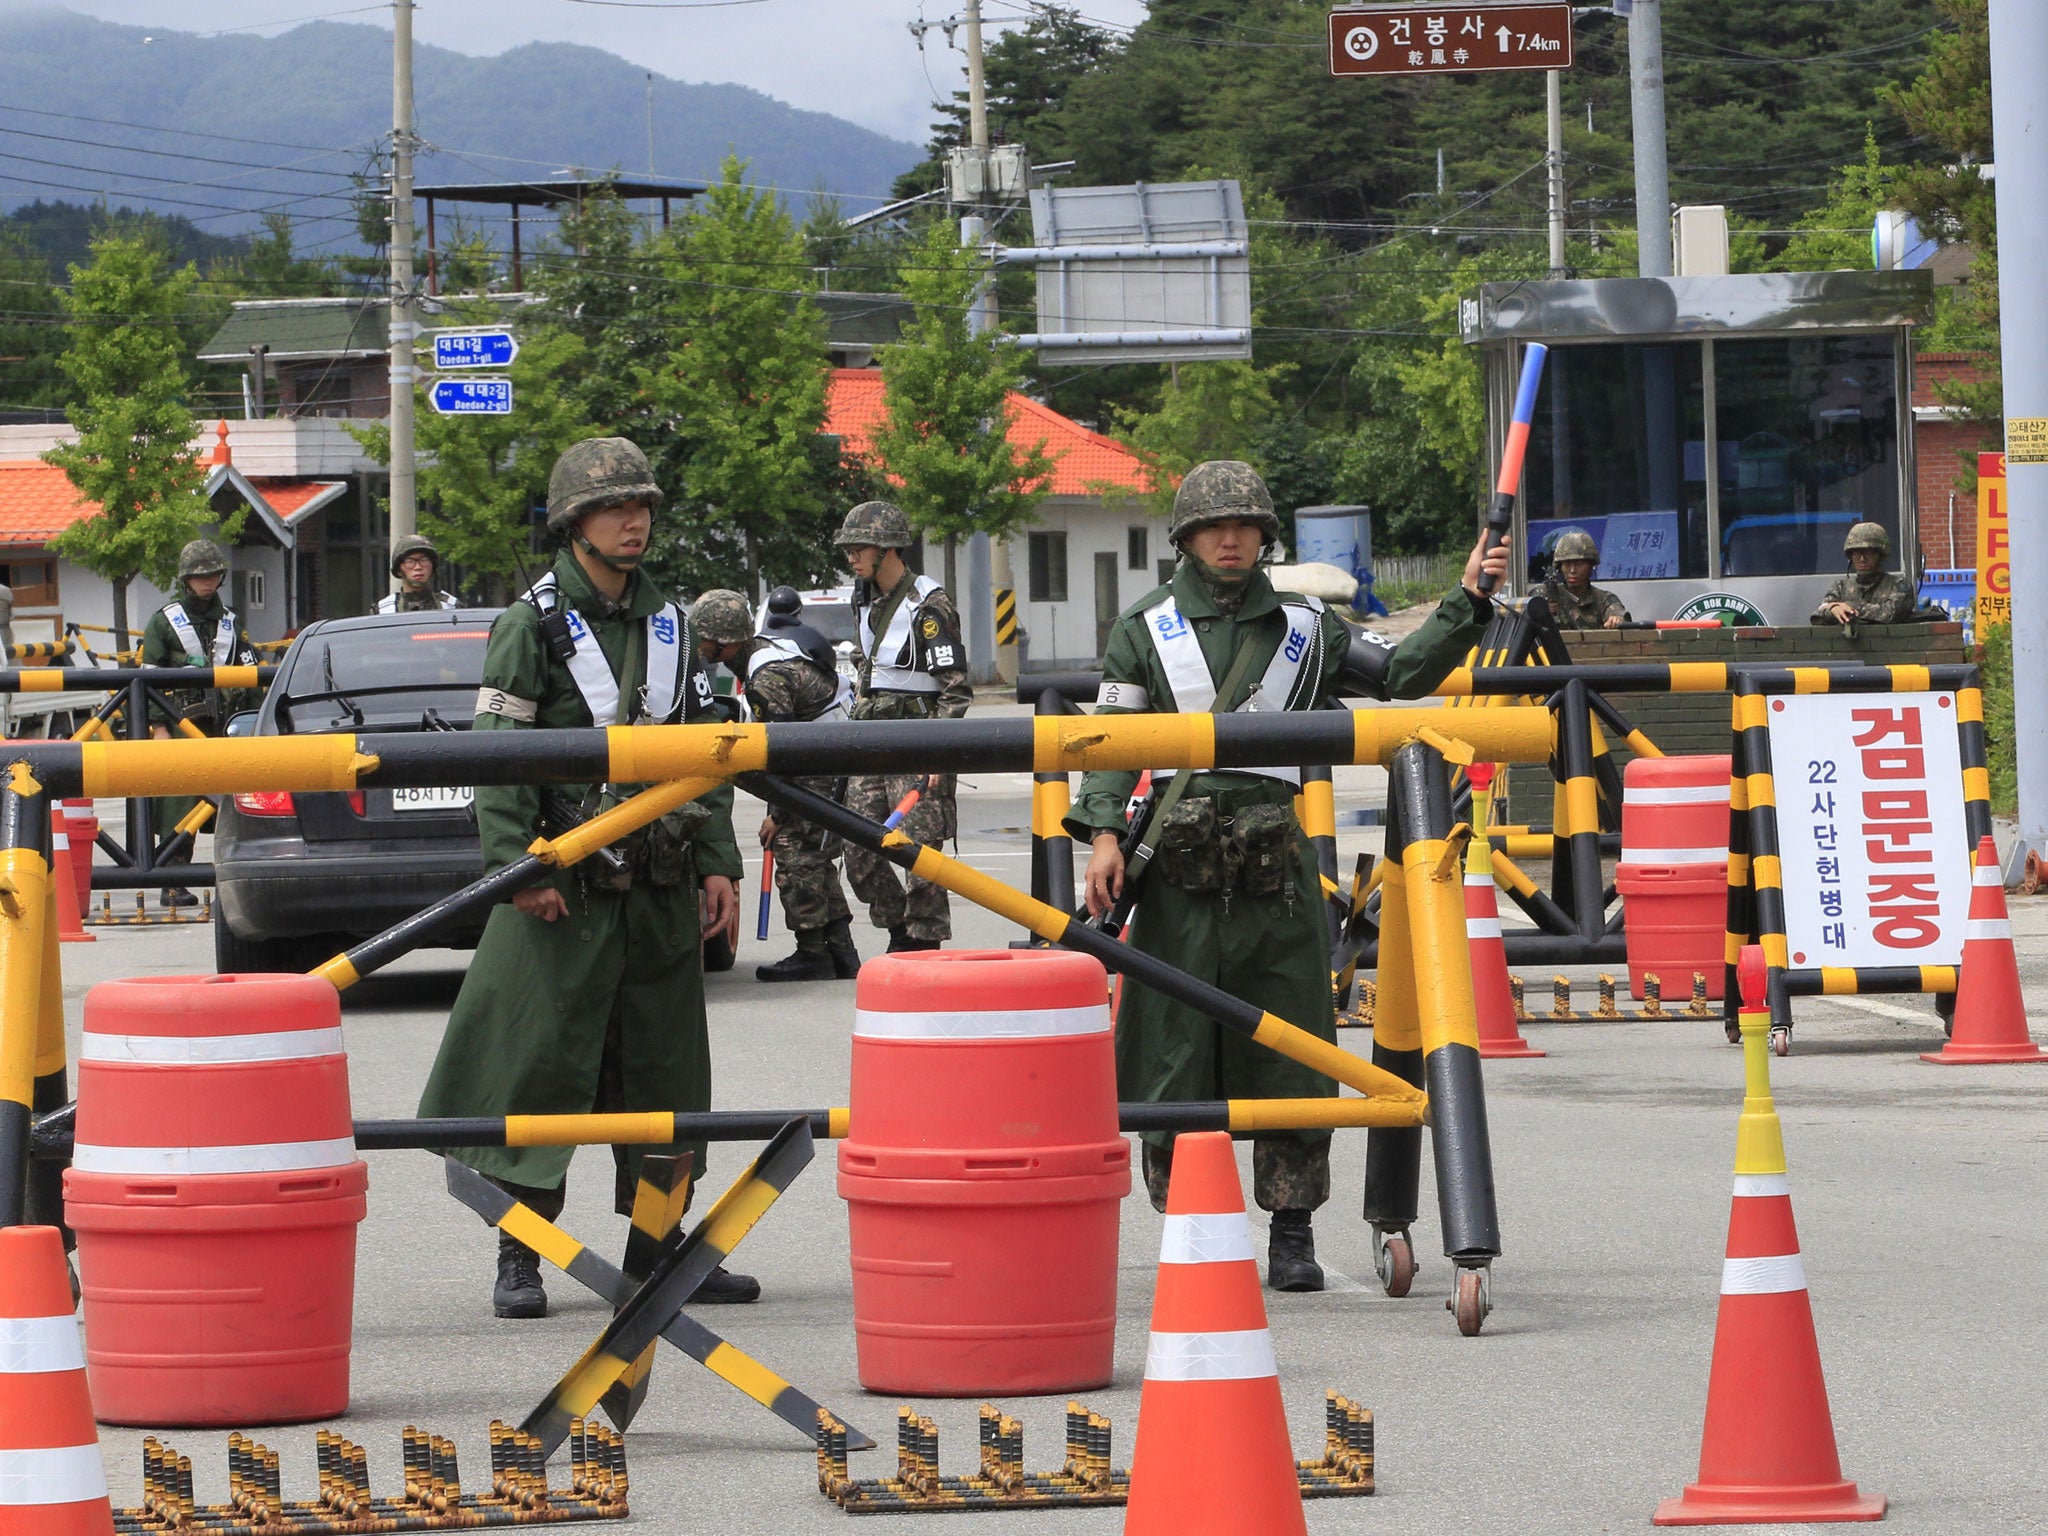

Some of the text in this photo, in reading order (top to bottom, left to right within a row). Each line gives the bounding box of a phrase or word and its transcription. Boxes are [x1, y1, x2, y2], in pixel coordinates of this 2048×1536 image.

[1516, 33, 1560, 51] 7.4km
[1408, 48, 1469, 66] 乾鳳寺
[439, 338, 482, 352] 대대1길
[440, 354, 492, 364] Daedae 1-gil
[463, 384, 506, 399] 대대2길
[454, 400, 507, 411] Daedae 2-gil
[1627, 530, 1664, 550] 제7회
[1703, 598, 1722, 609] ROK
[1725, 598, 1750, 614] ARMY
[1154, 608, 1188, 641] 헌
[1284, 627, 1307, 663] 병
[489, 692, 507, 711] 승
[1106, 684, 1120, 703] 승
[1850, 706, 1942, 949] 검문중
